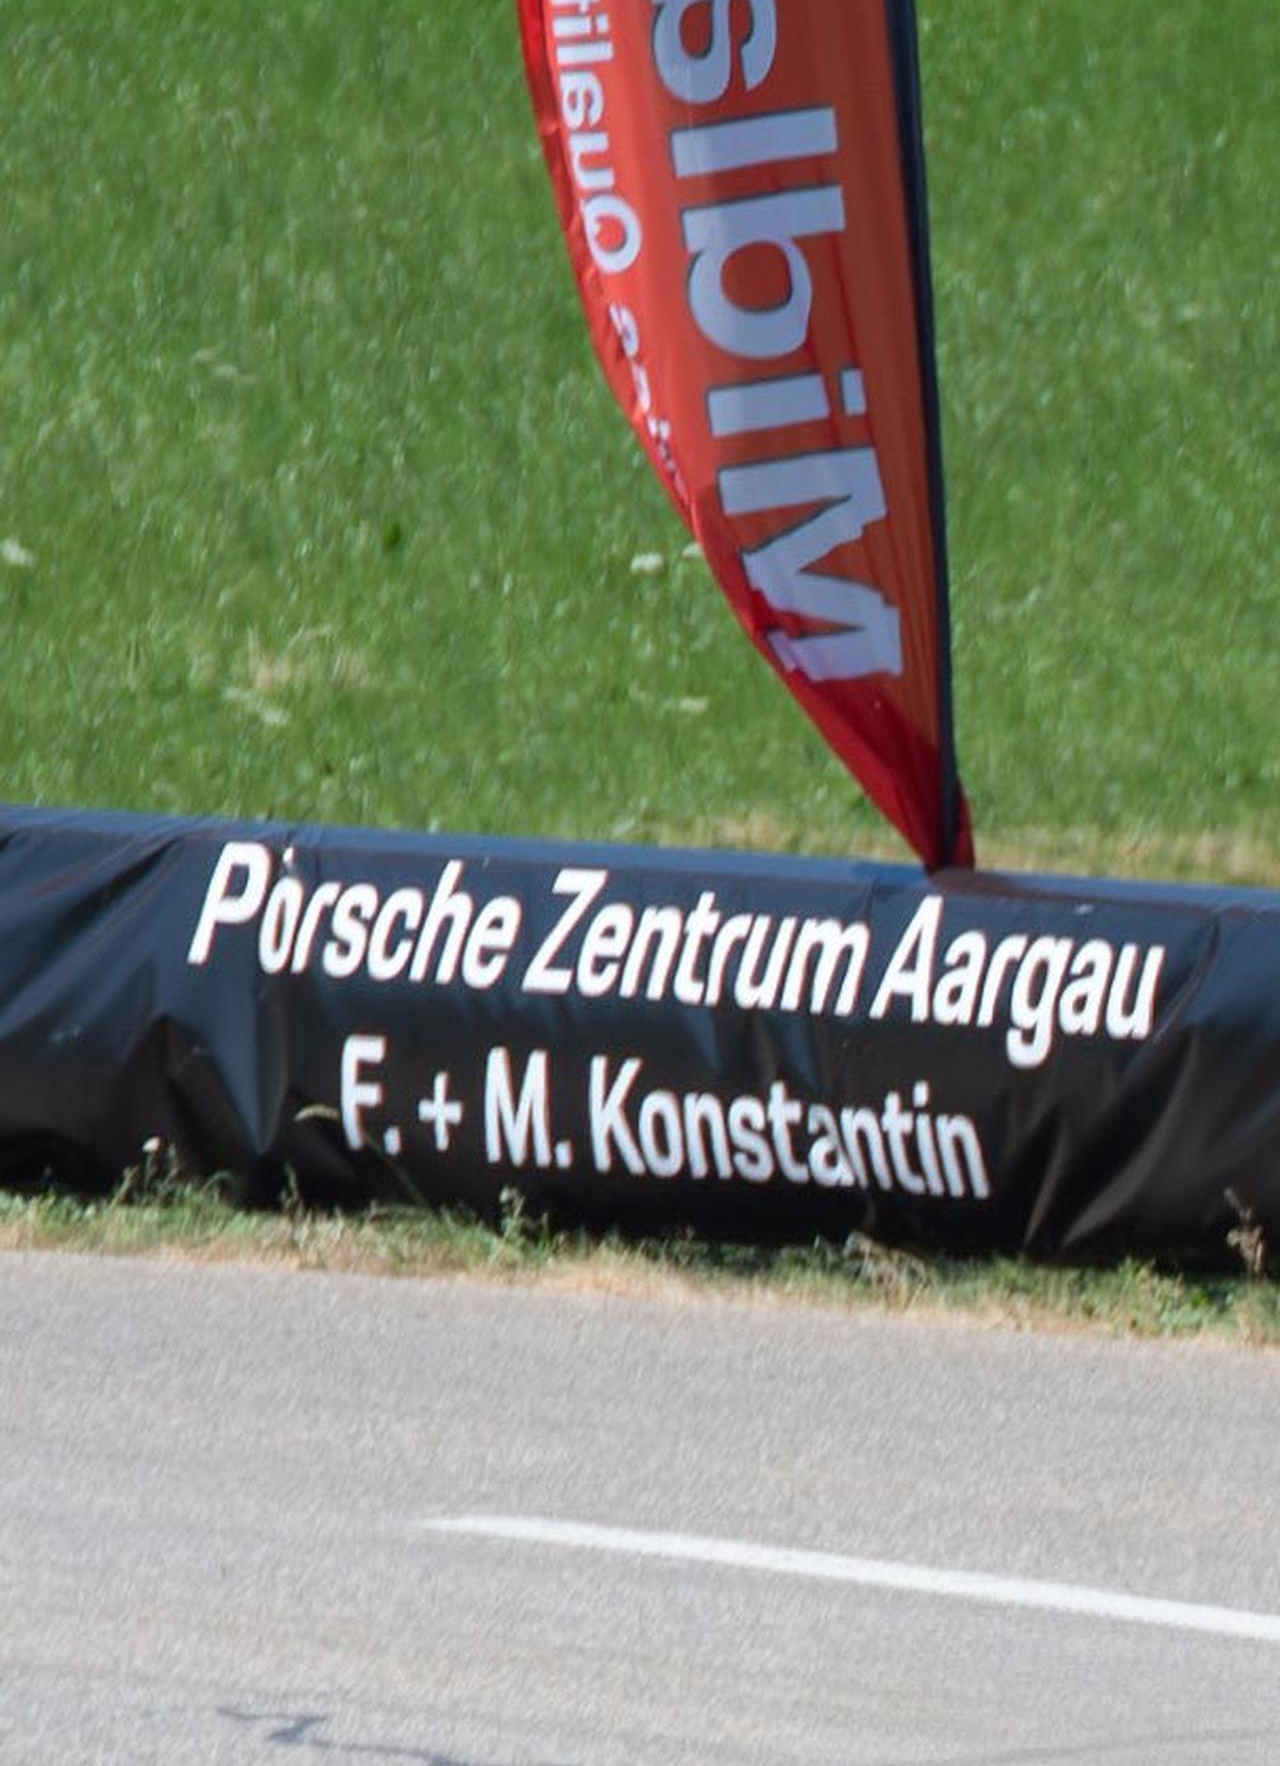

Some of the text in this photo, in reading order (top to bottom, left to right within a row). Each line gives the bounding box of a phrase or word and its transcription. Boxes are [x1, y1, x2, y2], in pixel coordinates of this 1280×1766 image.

[189, 840, 1167, 1070] Porsche Zentrum Aargau
[417, 1070, 464, 1152] +
[484, 1045, 571, 1171] M.
[590, 1055, 989, 1200] Konstantin
